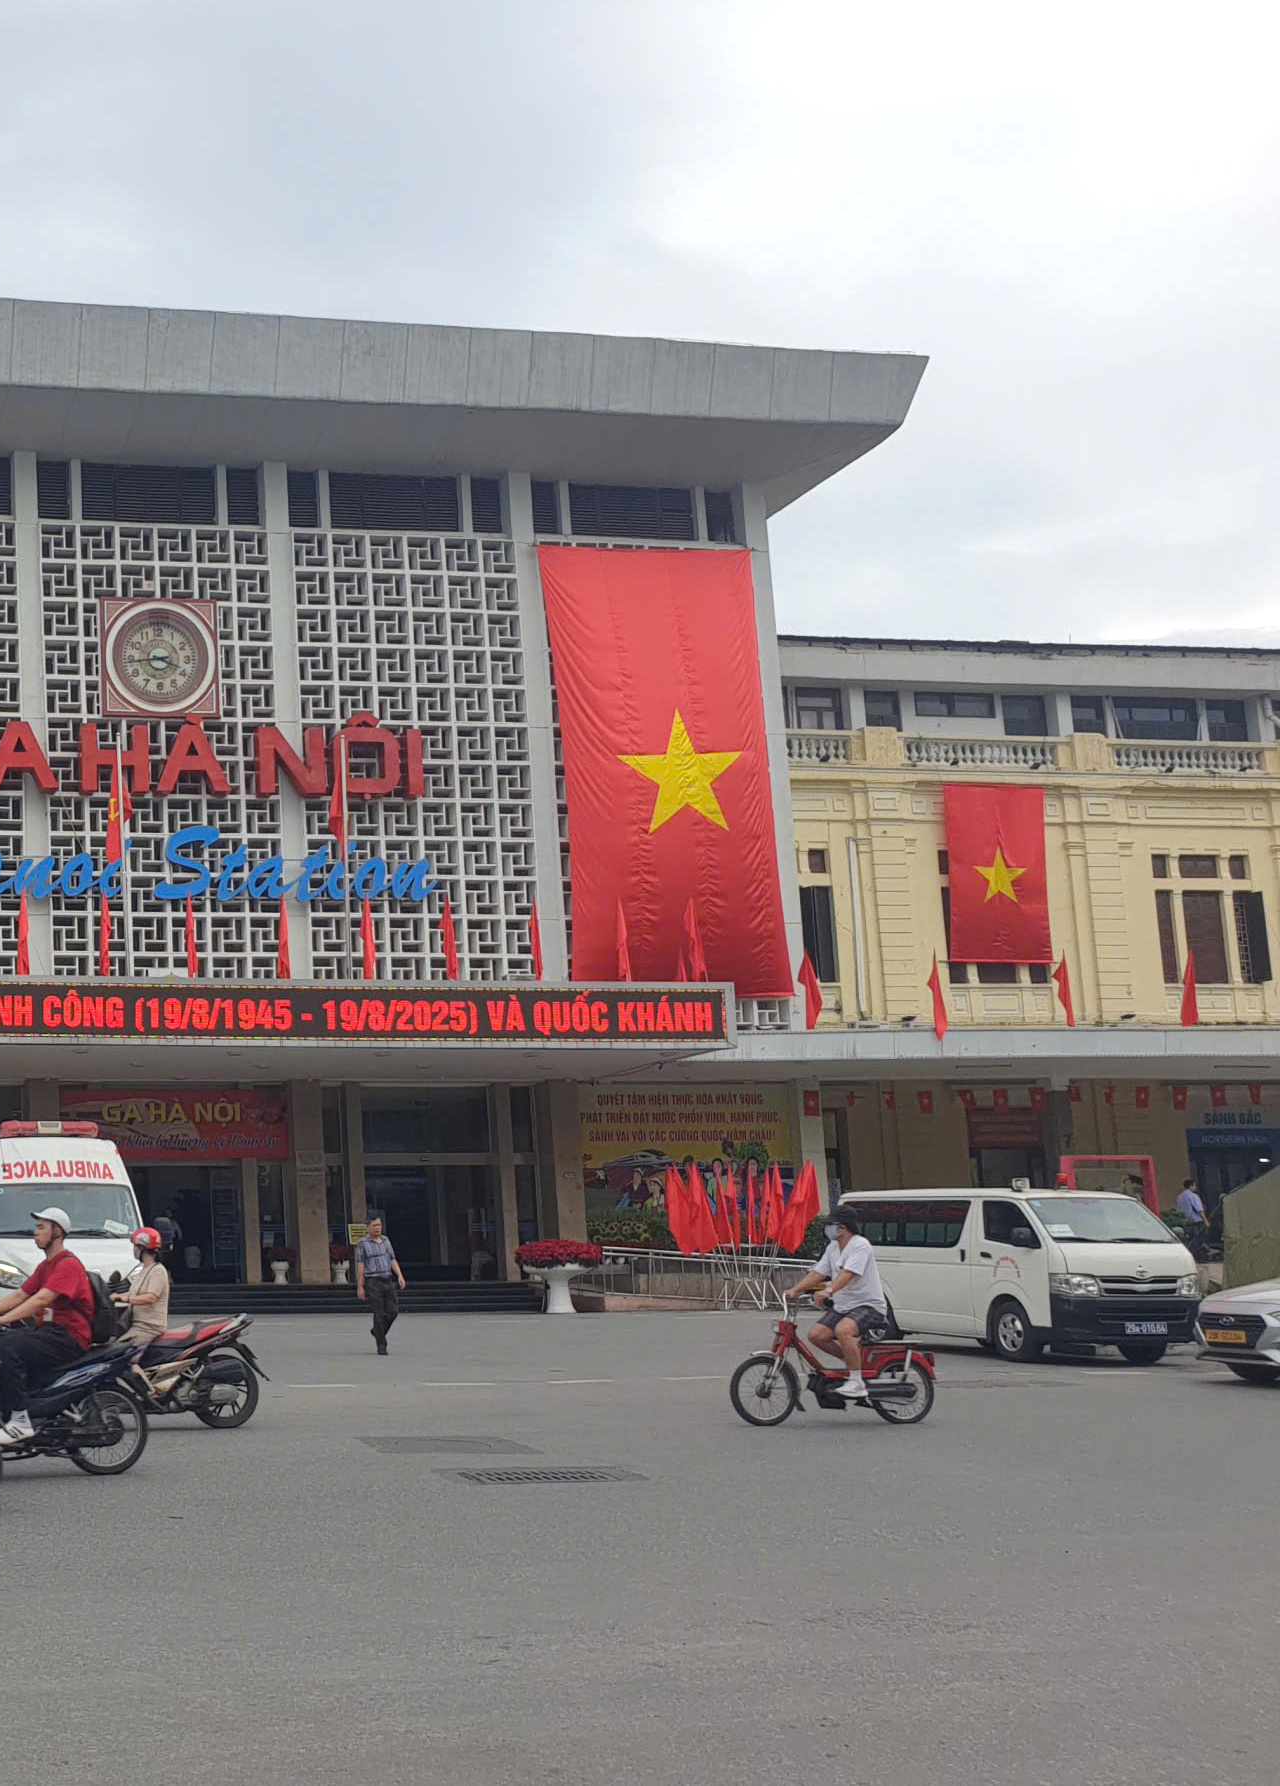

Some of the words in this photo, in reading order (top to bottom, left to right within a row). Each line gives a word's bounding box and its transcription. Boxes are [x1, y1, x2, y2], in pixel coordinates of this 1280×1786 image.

[140, 631, 149, 640] 11
[152, 628, 163, 637] 12
[131, 641, 141, 650] 10
[179, 642, 186, 650] 2
[184, 655, 190, 664] 3
[132, 669, 139, 677] 8
[143, 679, 150, 689] 7
[156, 682, 163, 690] 6
[170, 679, 177, 688] 5
[79, 713, 233, 798] HÀ
[254, 711, 423, 800] NỘI
[153, 825, 439, 902] Station
[43, 989, 124, 1028] CÔNG
[135, 998, 292, 1032] (19/8/1945
[322, 1000, 478, 1034] 19/8/2025)
[487, 994, 526, 1031] VÀ
[533, 990, 609, 1035] QUỐC
[618, 995, 713, 1032] KHÁNH
[103, 1103, 145, 1124] GA
[148, 1097, 190, 1124] HÀ
[194, 1097, 242, 1128] NỘI
